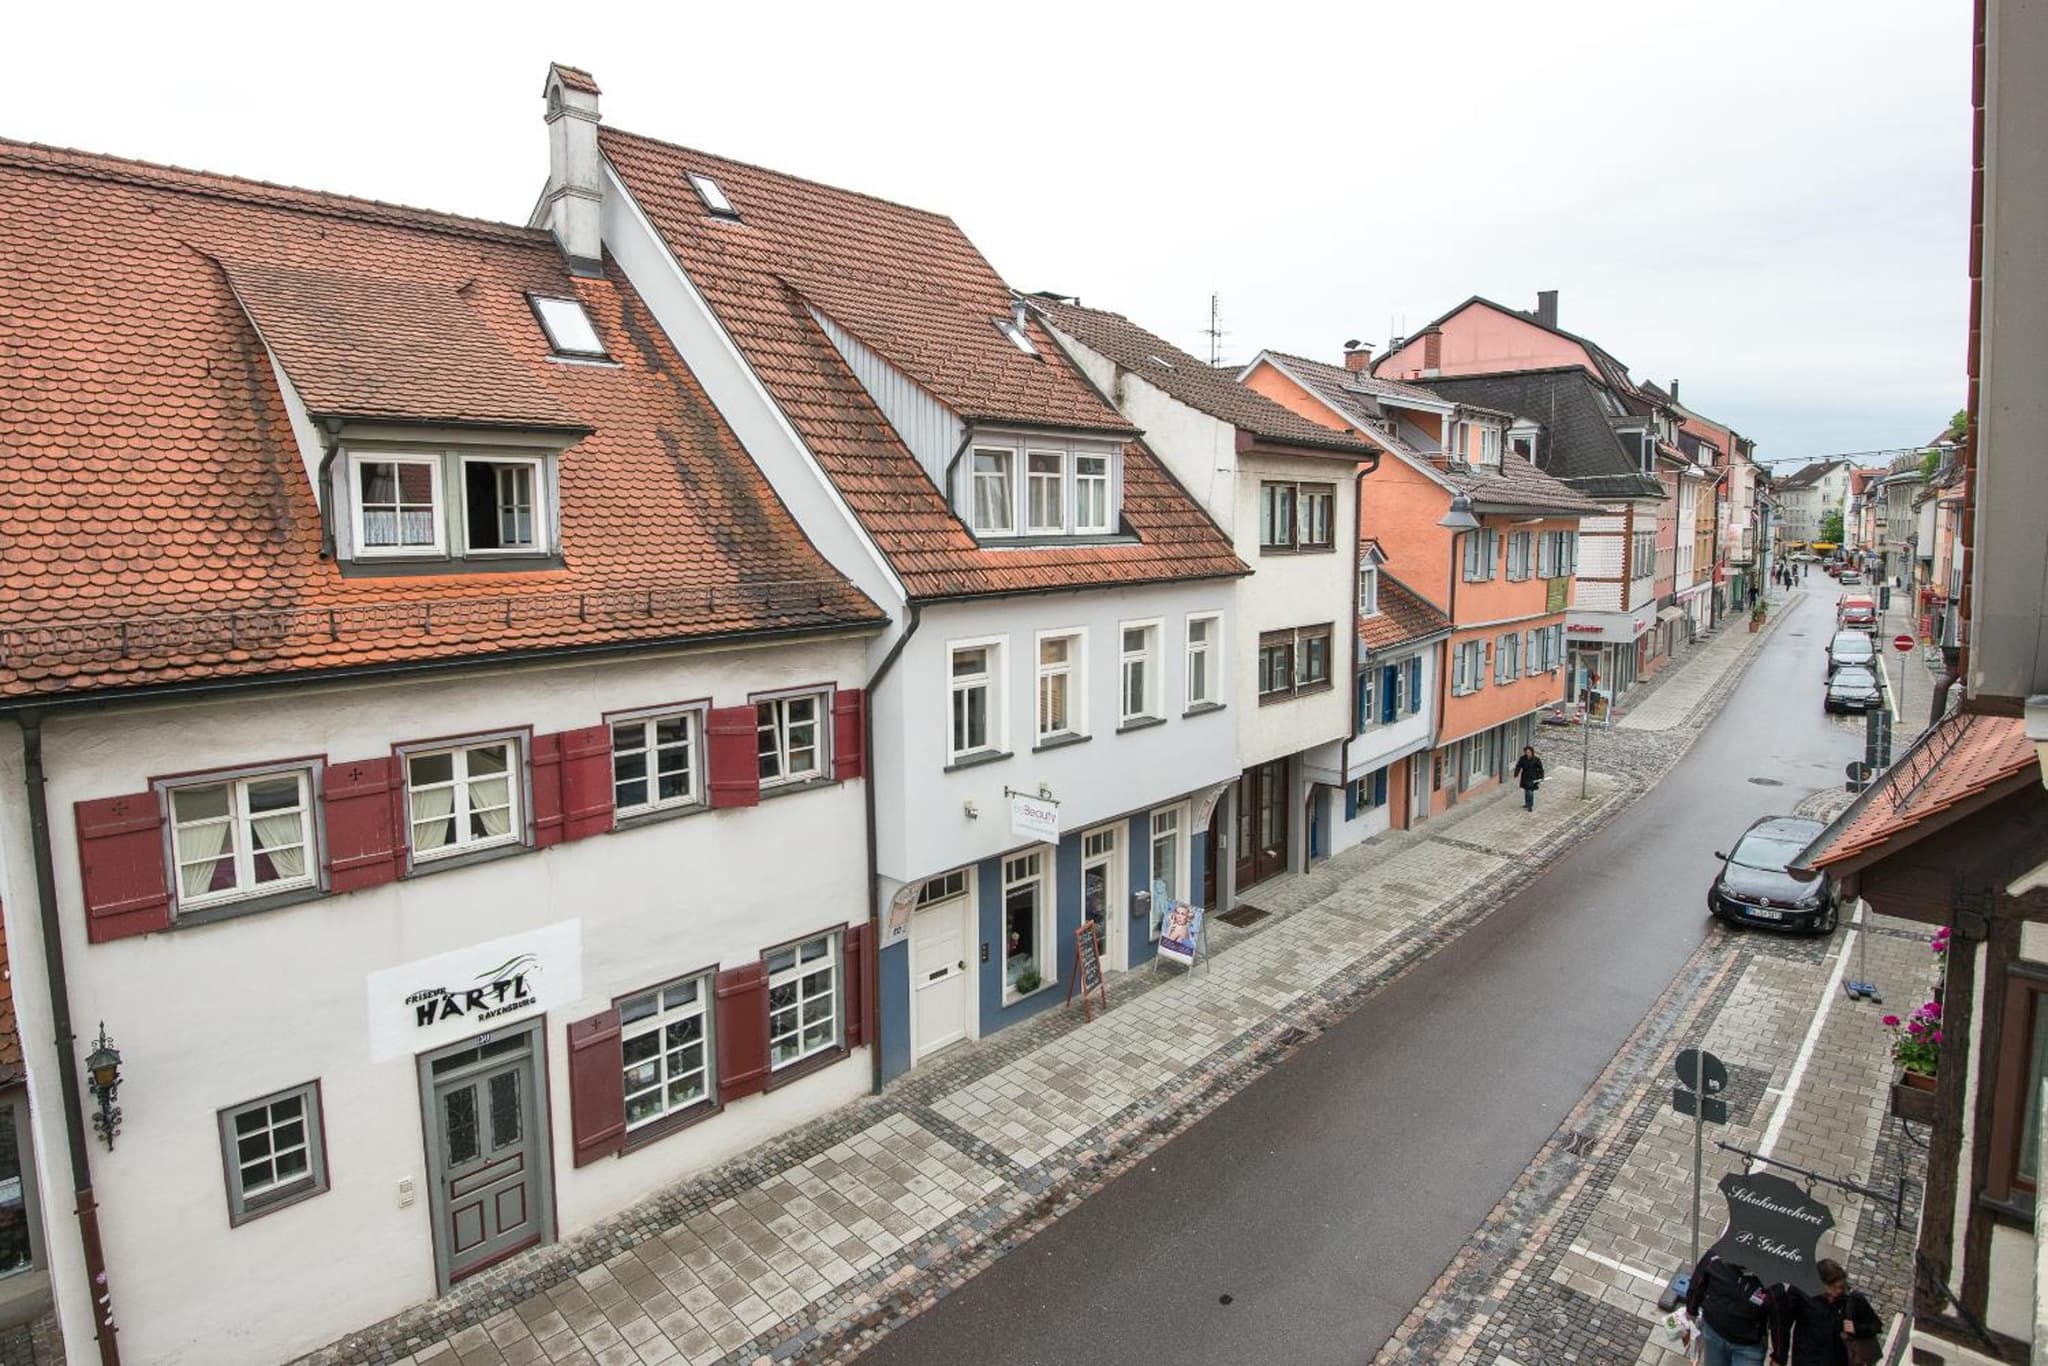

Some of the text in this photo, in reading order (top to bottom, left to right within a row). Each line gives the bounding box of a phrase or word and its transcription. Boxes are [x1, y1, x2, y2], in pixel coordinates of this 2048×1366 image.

[405, 986, 447, 1005] FRISEUR
[417, 975, 527, 1026] HÄRTL
[478, 997, 537, 1021] RAVENSBURG
[1728, 1186, 1824, 1225] Schuhmacherei
[1757, 1236, 1803, 1262] Gehrke
